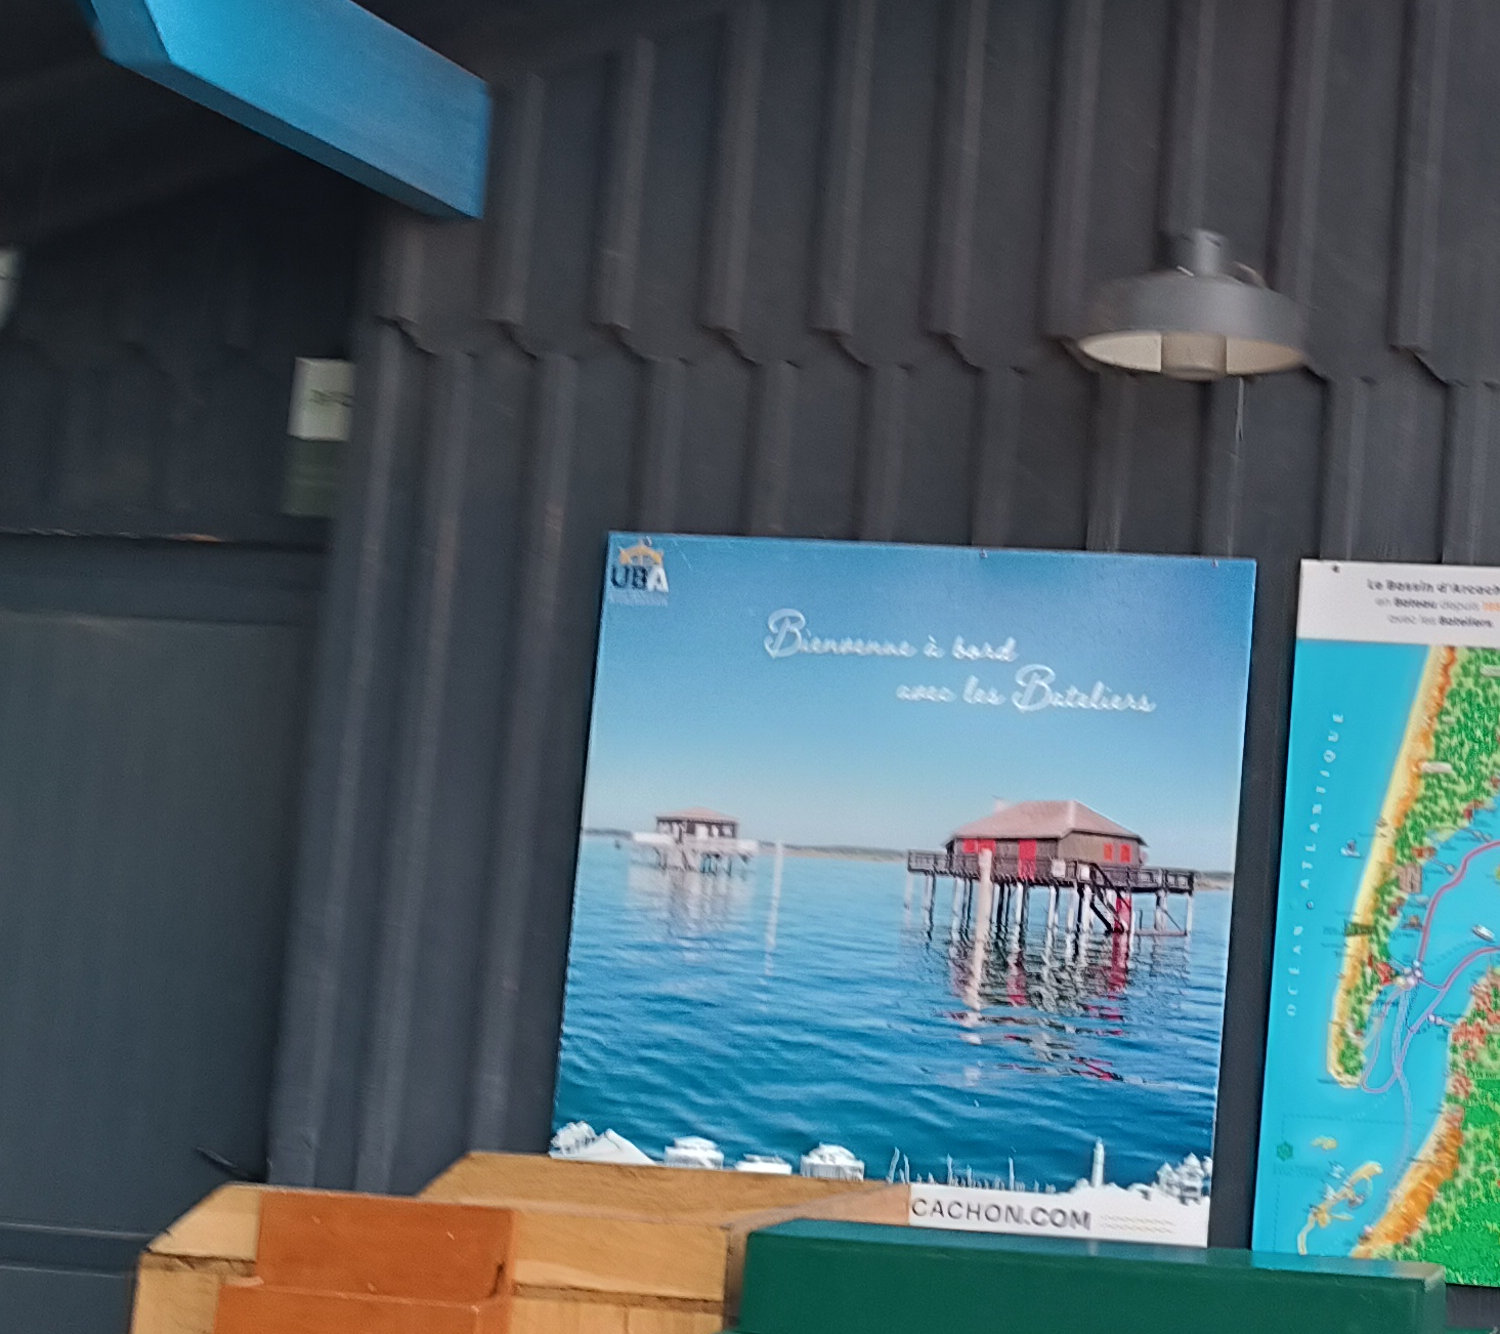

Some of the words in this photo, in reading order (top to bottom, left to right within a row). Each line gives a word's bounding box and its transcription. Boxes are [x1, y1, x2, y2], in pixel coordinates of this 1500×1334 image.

[611, 566, 669, 593] UBA
[1367, 579, 1383, 591] Le
[1386, 579, 1434, 594] Bassin
[763, 608, 917, 659] Bienvenue
[923, 635, 944, 659] à
[952, 636, 1020, 662] bord
[896, 682, 957, 704] avec
[963, 674, 1006, 706] les
[1011, 664, 1157, 713] Bateliers
[911, 1198, 1092, 1231] CACHON.COM
